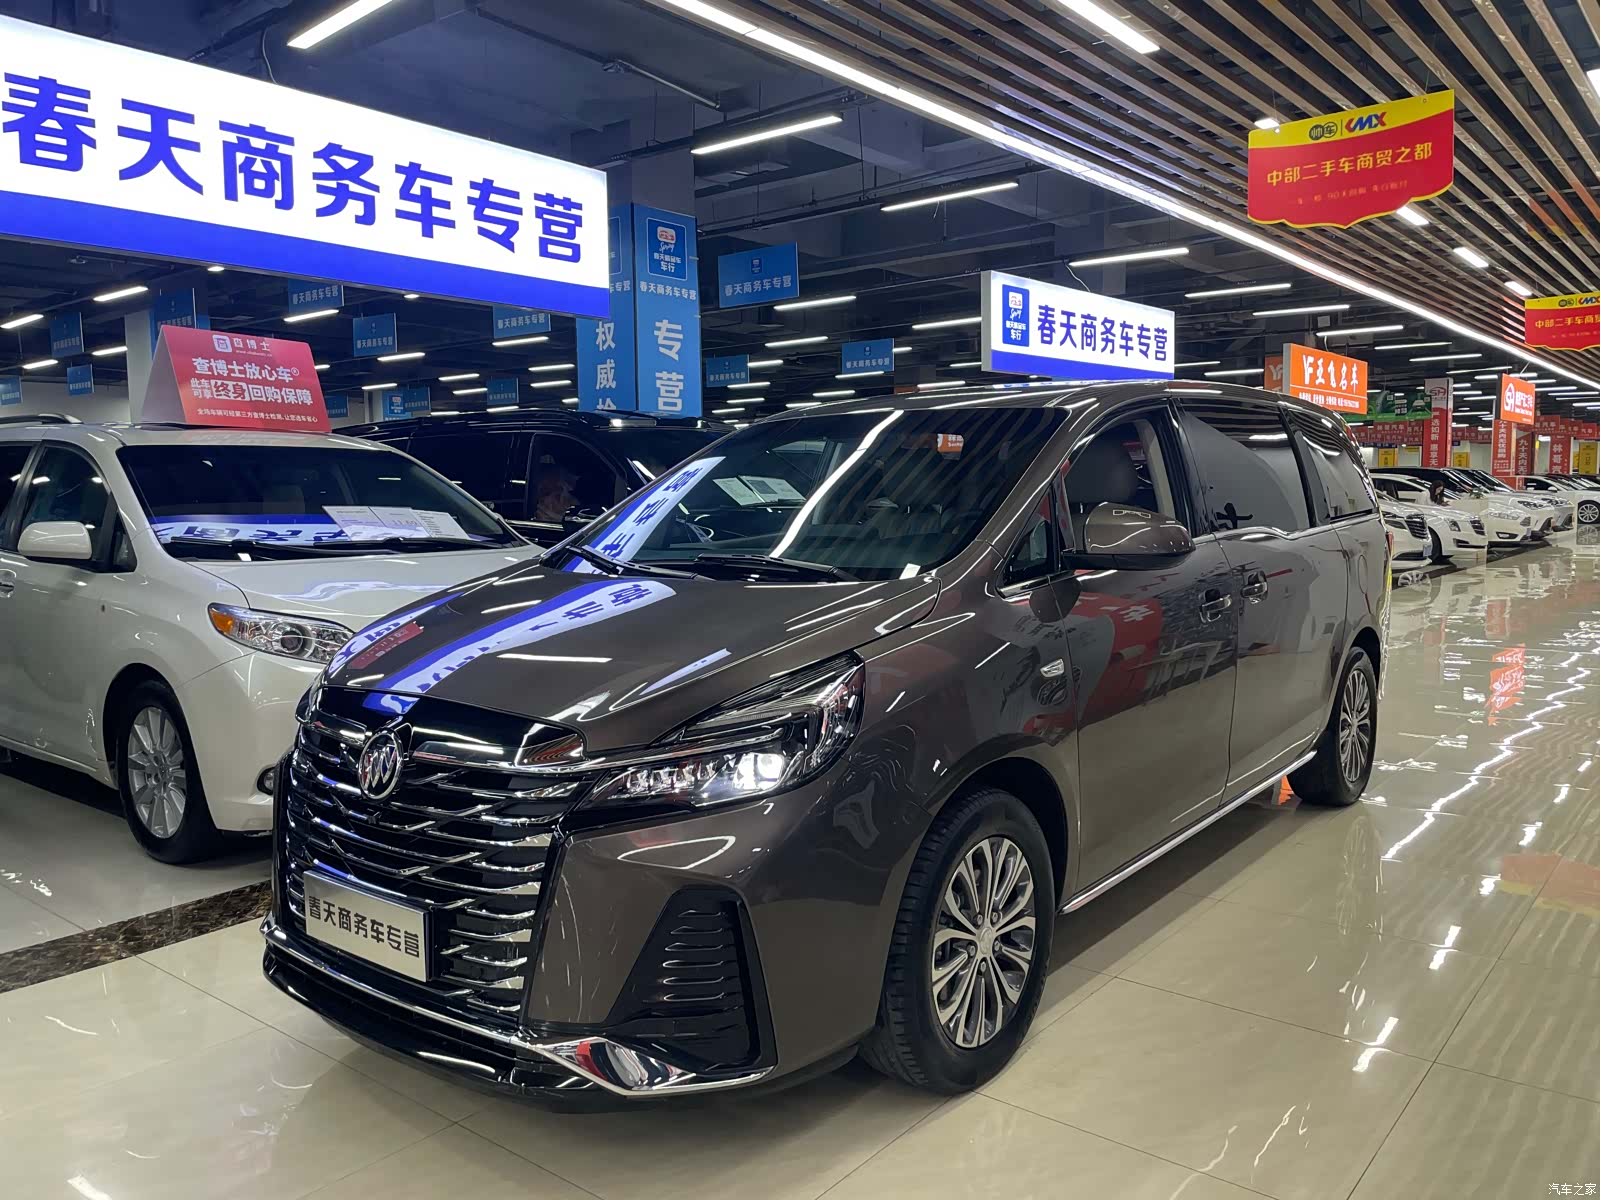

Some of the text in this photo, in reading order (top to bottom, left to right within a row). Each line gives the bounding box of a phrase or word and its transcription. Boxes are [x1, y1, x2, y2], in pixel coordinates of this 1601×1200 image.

[3, 72, 583, 264] 春天商务车专营
[1267, 142, 1432, 187] 中部二手车商贸之都
[640, 281, 697, 300] 春天商务车专营
[724, 275, 792, 297] 春天商务车专营
[1037, 304, 1168, 362] 春天商务车专营
[213, 380, 313, 405] 终身回购保障
[309, 895, 420, 958] 春天商务车专营
